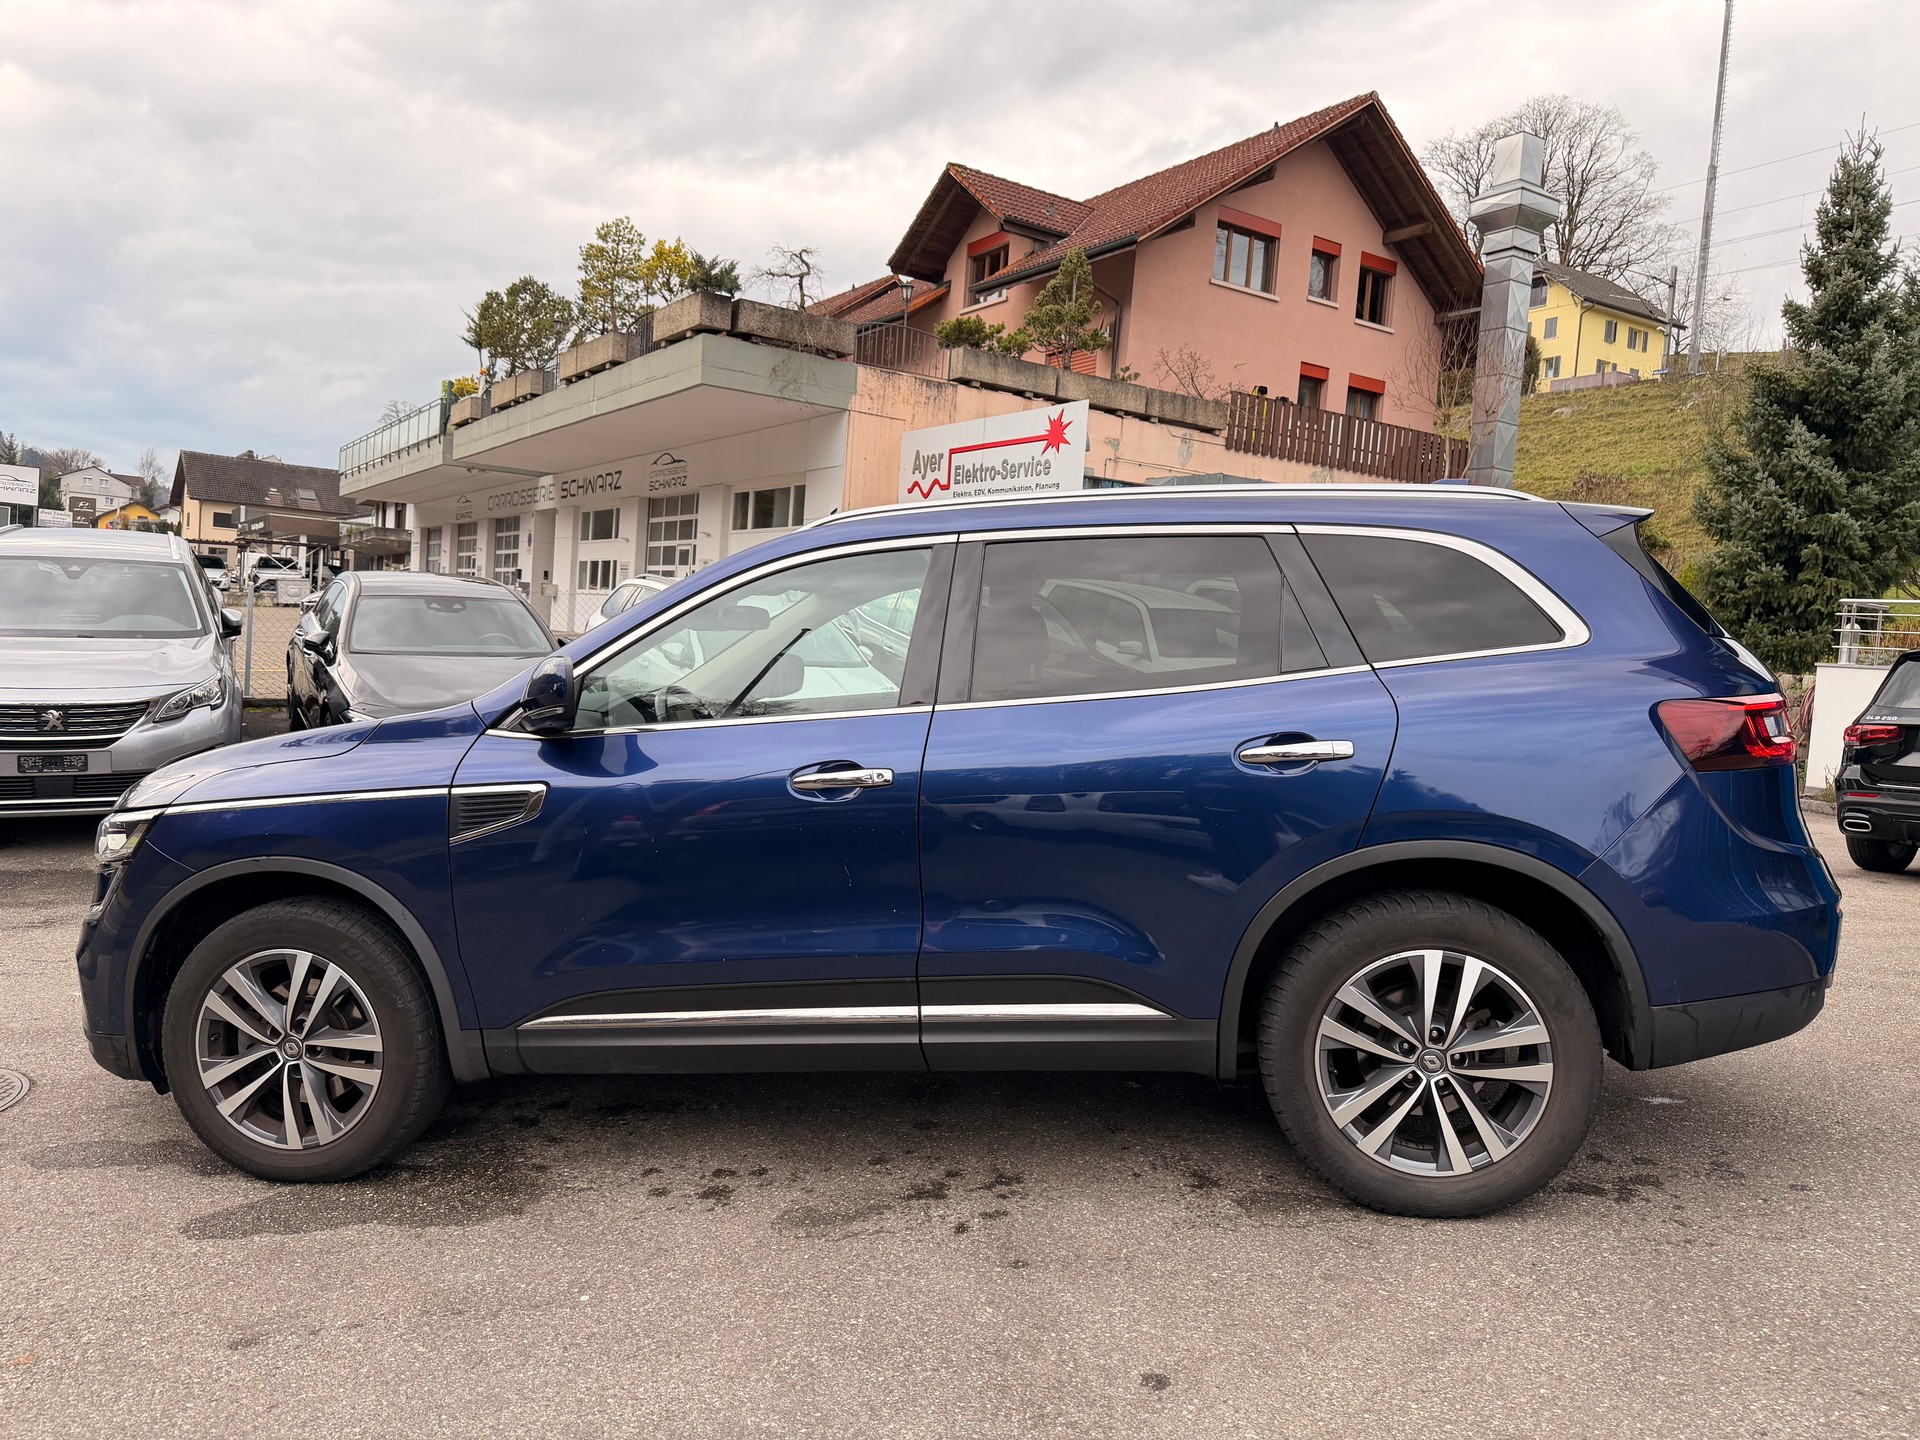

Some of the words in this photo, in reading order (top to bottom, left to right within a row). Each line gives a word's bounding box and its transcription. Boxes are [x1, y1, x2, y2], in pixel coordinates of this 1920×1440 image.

[650, 465, 688, 478] CARROSSERIE
[912, 449, 944, 480] Ayer
[953, 456, 1051, 485] Elektro-Service
[487, 483, 555, 511] CARROSSERIE
[560, 470, 622, 499] SCHWARZ
[649, 475, 688, 491] SCHWARZ
[974, 488, 987, 497] EDV,
[987, 485, 1034, 495] Kommunikation,
[1035, 482, 1060, 491] Planung
